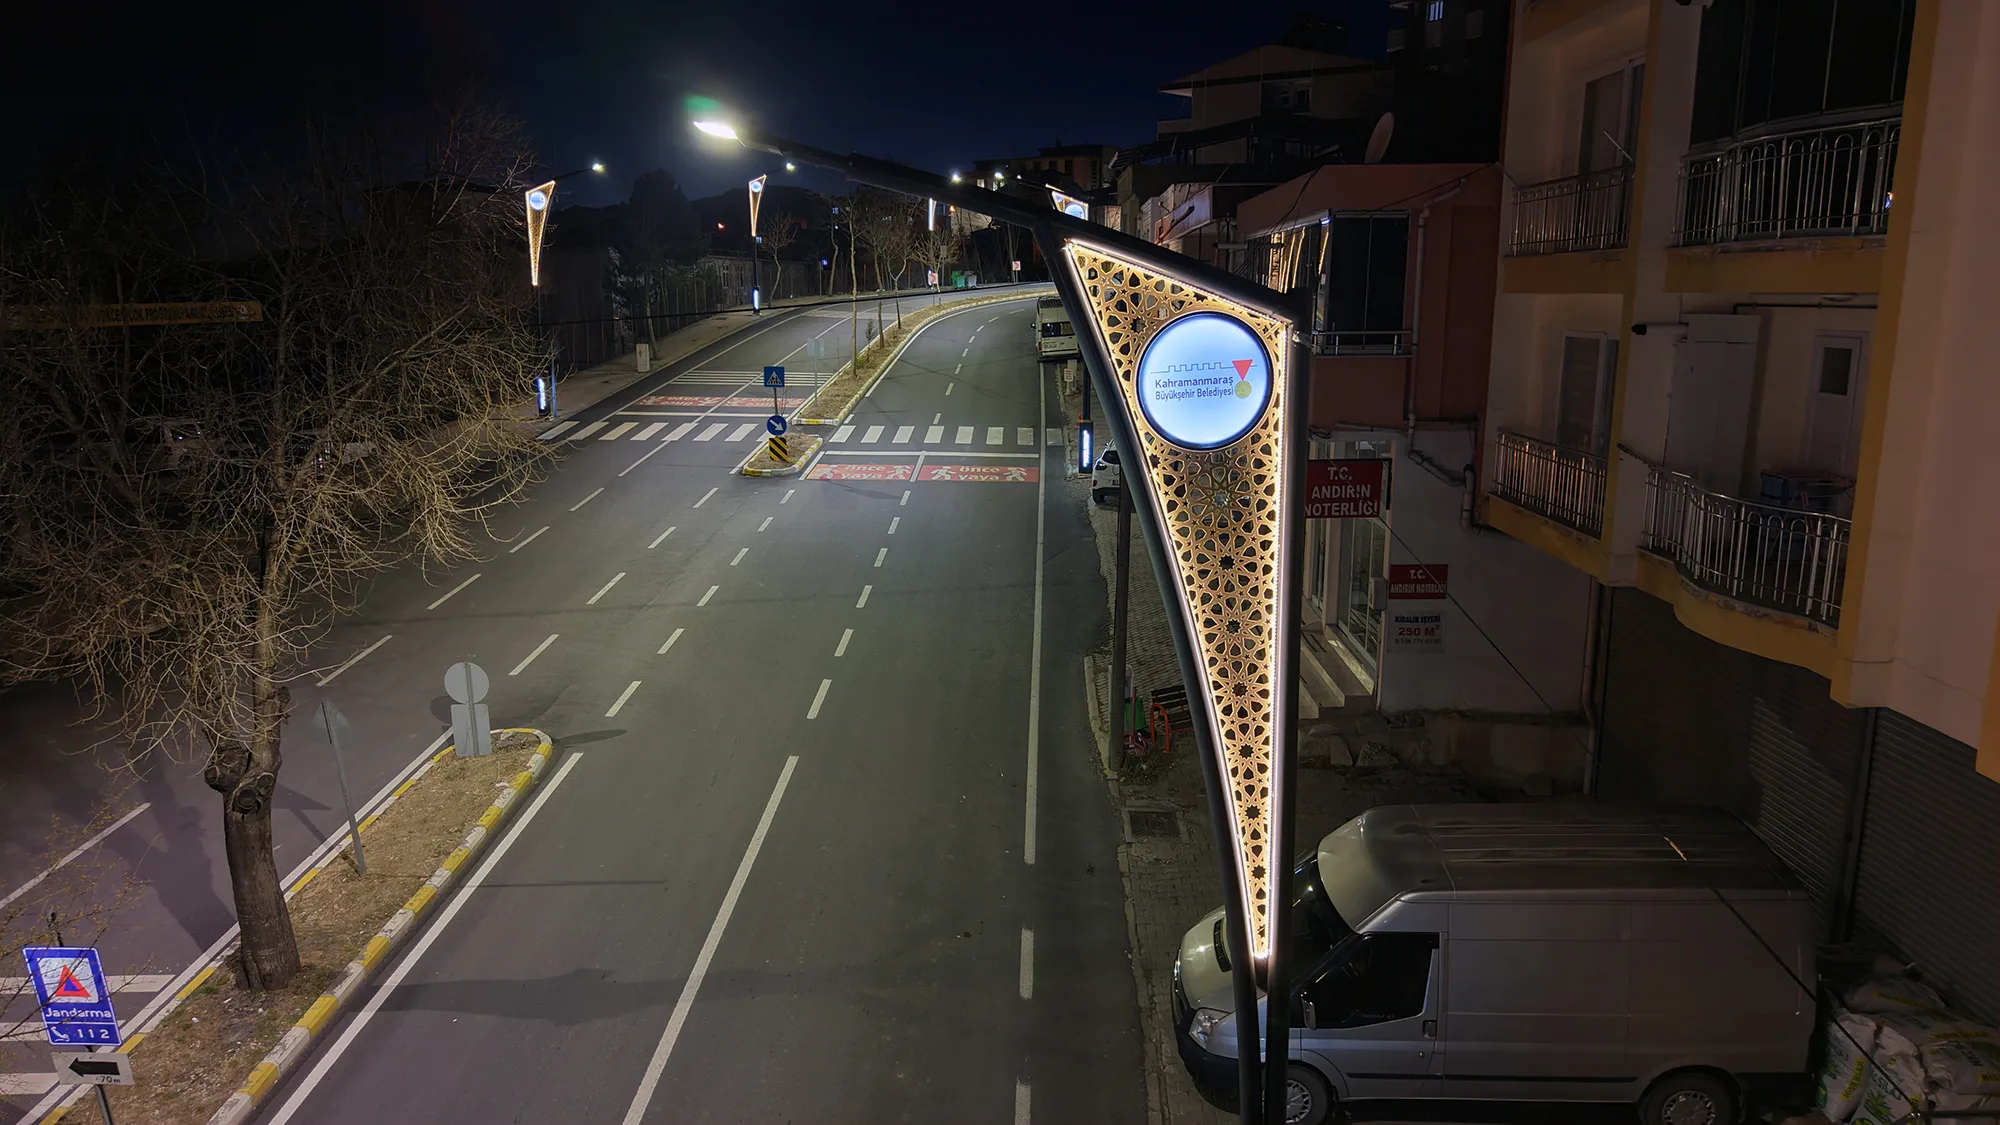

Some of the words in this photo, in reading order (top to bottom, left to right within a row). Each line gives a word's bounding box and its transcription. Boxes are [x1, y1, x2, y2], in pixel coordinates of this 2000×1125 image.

[1155, 377, 1234, 388] Kahramanmaraş
[1156, 388, 1195, 401] Büyükşehir
[1197, 386, 1234, 399] Belediyesi
[1327, 466, 1352, 480] T.C.
[1311, 484, 1371, 499] ANDIRIN
[1409, 569, 1425, 579] T.C.
[1390, 583, 1415, 593] ANDIRIN
[1395, 614, 1419, 623] KİRALIK
[1398, 627, 1420, 636] 250
[45, 1007, 112, 1018] Jandarma
